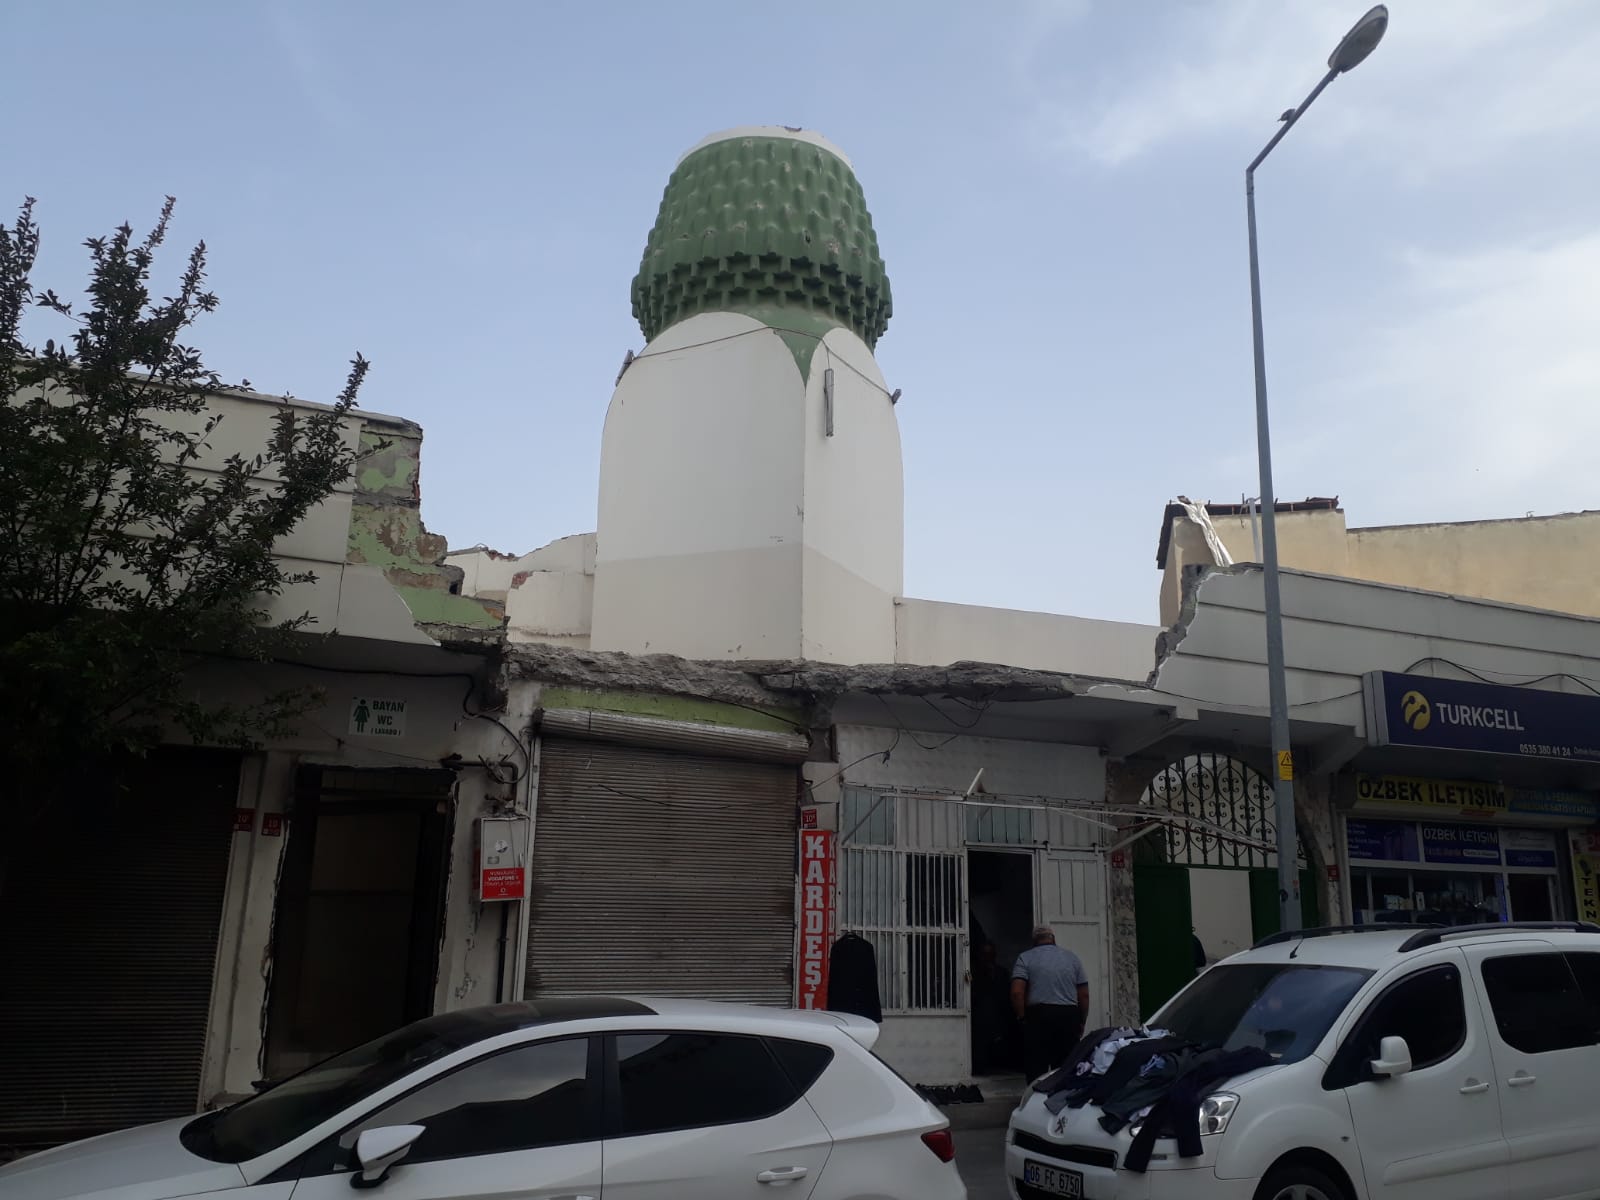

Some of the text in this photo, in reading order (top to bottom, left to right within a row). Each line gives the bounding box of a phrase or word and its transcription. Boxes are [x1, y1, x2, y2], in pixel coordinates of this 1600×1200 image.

[373, 700, 405, 713] BAYAN
[1436, 702, 1525, 731] TURKCELL
[377, 714, 393, 726] WC
[1030, 1166, 1080, 1195] 06 FC 6750
